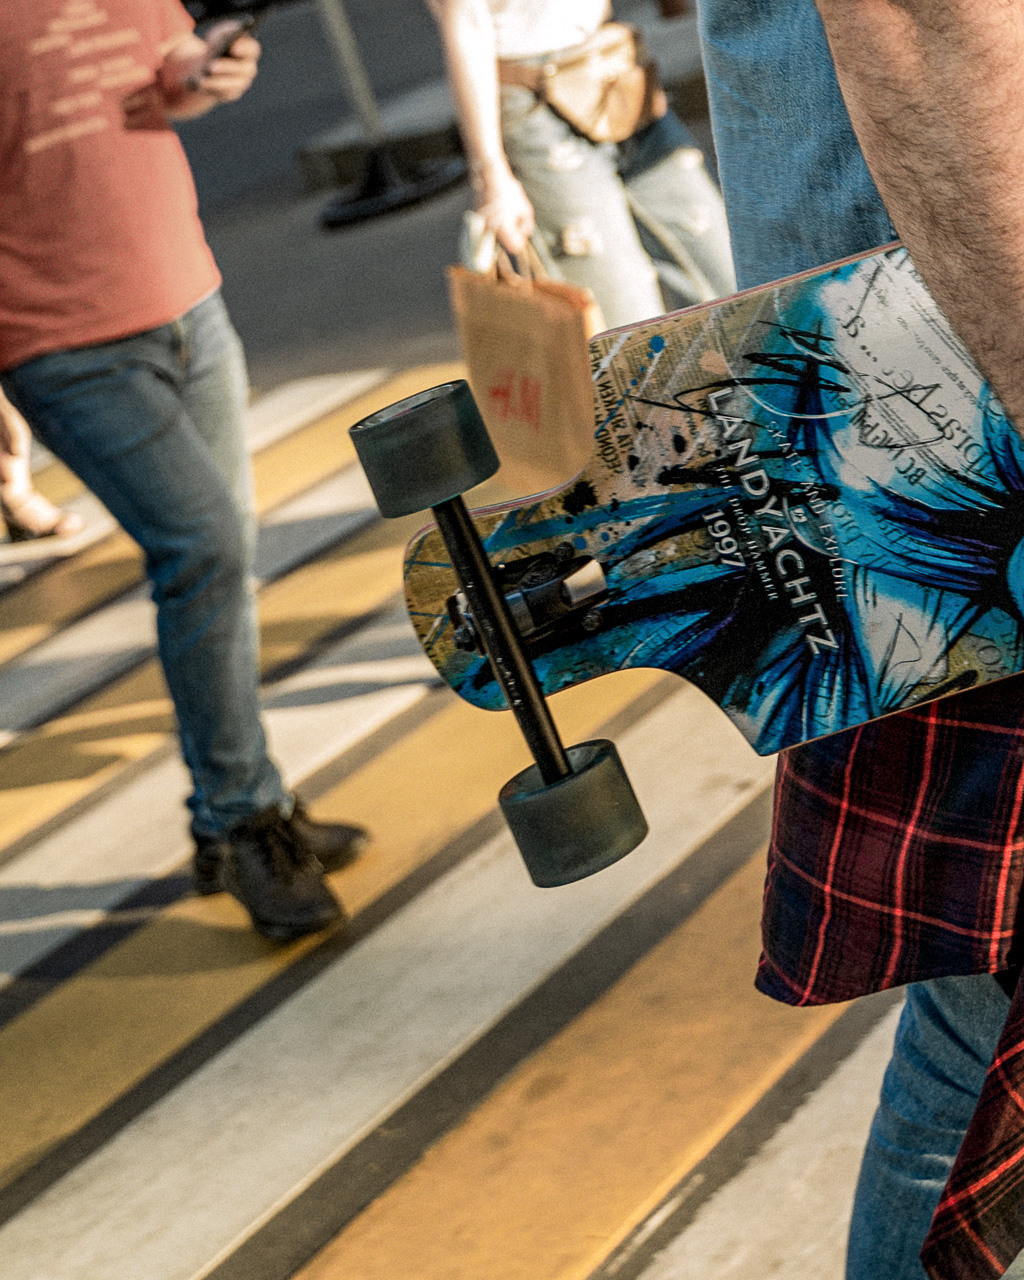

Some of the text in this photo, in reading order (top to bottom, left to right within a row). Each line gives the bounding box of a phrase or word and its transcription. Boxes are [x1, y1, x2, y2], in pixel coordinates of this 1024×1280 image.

[701, 507, 746, 567] 1997
[707, 385, 839, 656] LANDYACHTZ
[800, 479, 825, 515] AND
[819, 522, 848, 602] EXPLORE
[745, 538, 779, 601] HAMMER
